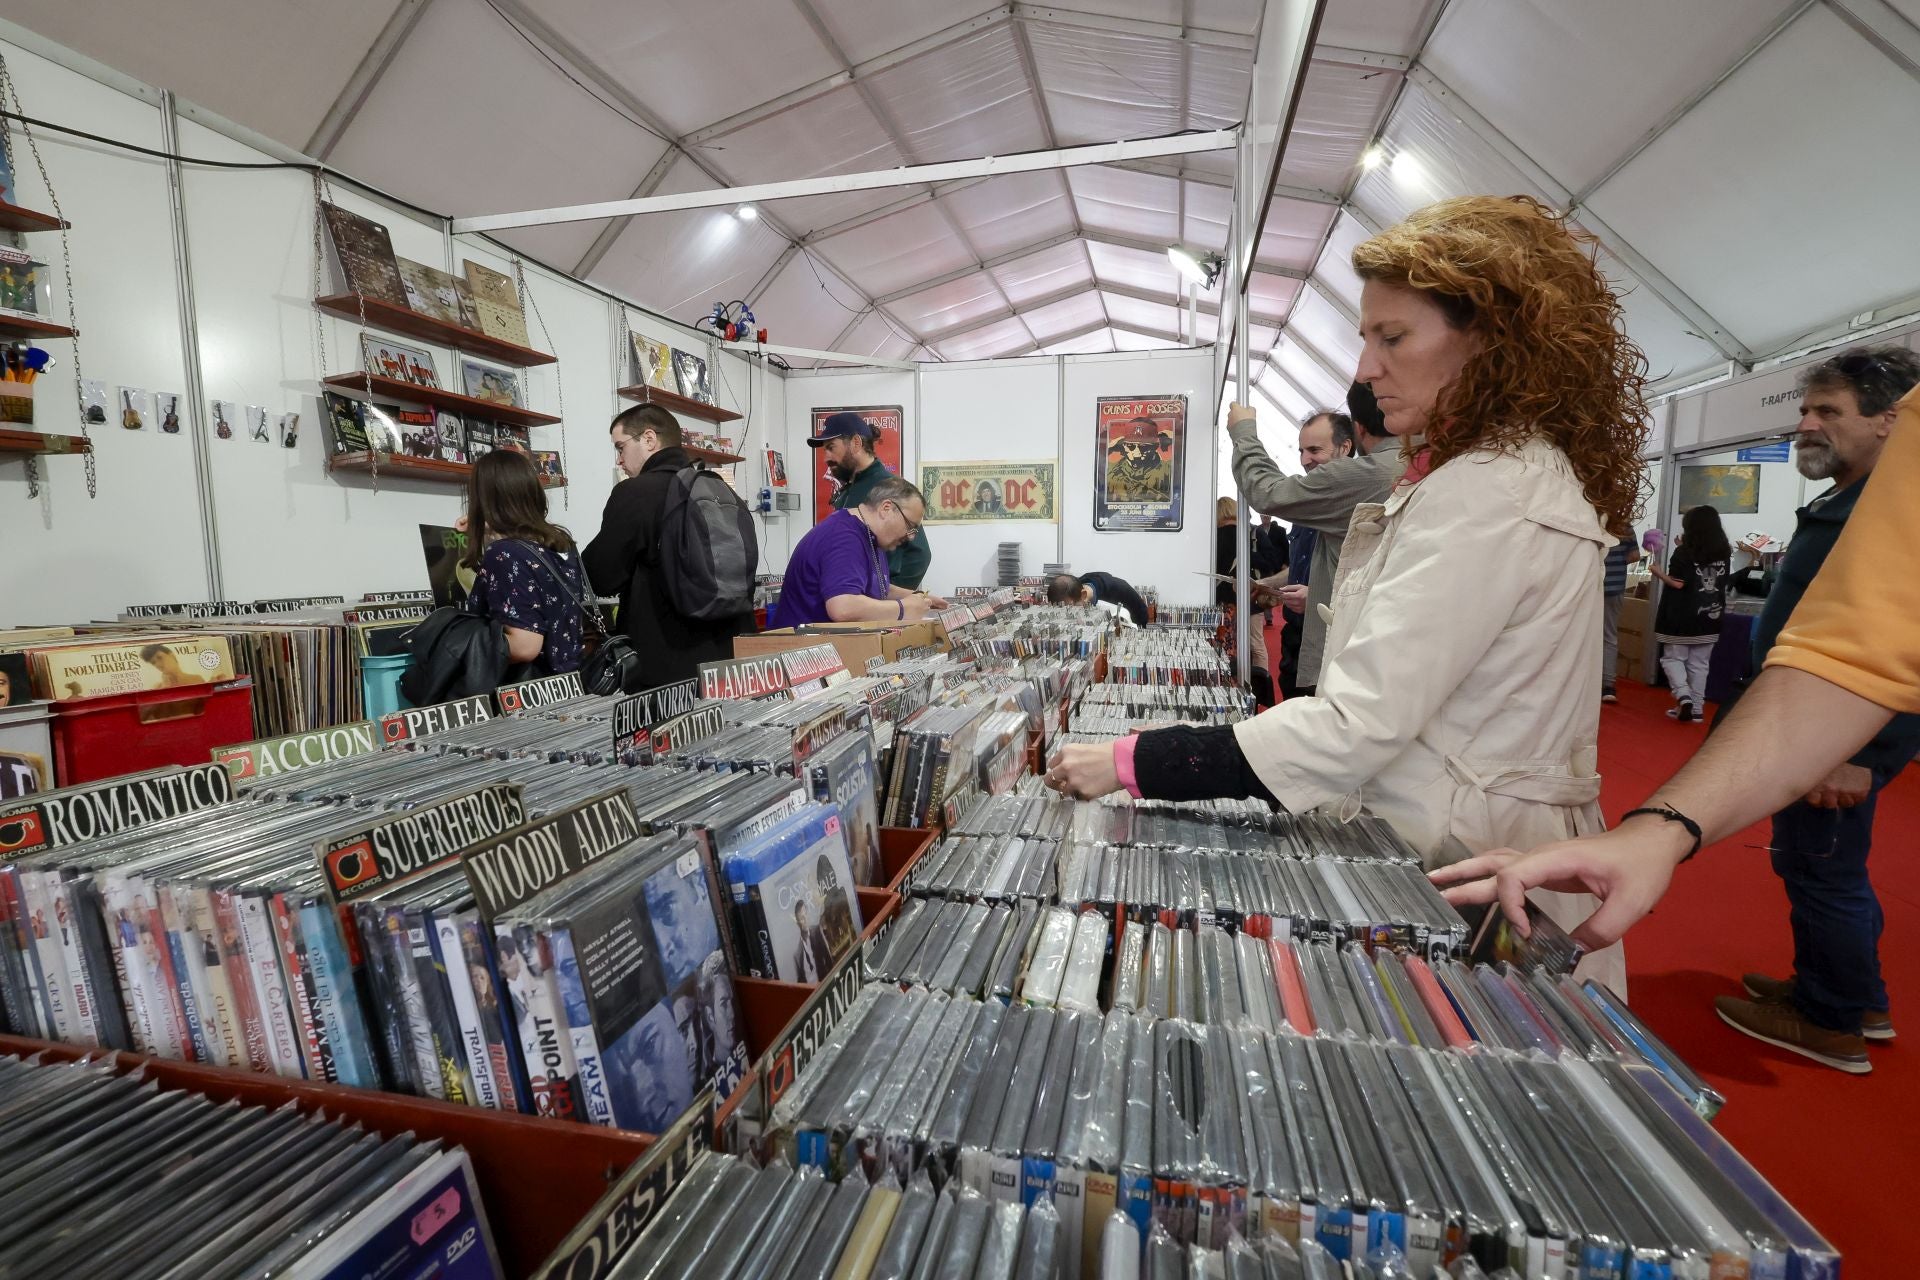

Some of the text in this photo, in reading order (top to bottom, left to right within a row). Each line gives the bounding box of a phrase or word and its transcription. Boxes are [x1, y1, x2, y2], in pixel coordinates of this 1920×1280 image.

[1103, 404, 1131, 415] GUNS
[1146, 402, 1181, 414] ROSES
[941, 478, 1037, 509] AC DC
[127, 606, 177, 618] MUSICA
[374, 591, 433, 602] BEATLES
[358, 609, 434, 623] KRAFTWERK
[64, 661, 141, 677] INOLVIDABLES
[91, 651, 139, 664] TITULOS
[519, 675, 583, 710] COMEDIA
[704, 658, 784, 700] FLAMENCO
[405, 698, 491, 739] PELEA
[615, 681, 696, 738] CHUCK NORRIS
[670, 707, 725, 750] POLITICO
[810, 709, 847, 751] MUSICAL
[258, 726, 375, 778] ACCION
[43, 766, 229, 849] ROMANTICO
[336, 834, 368, 849] BOMBA
[373, 786, 523, 880] SUPERHEROES
[468, 792, 641, 911] WOODY ALLEN
[339, 875, 383, 897] RECORDS
[586, 948, 607, 966] COLIN
[589, 960, 610, 977] SALLY
[74, 983, 89, 1018] DIARIO
[181, 981, 201, 1030] robada
[261, 958, 293, 1060] EL CARTERO
[594, 985, 611, 999] TOM
[791, 957, 863, 1079] ESPAÑOL
[533, 1015, 566, 1081] POINT
[446, 1226, 476, 1259] DVD
